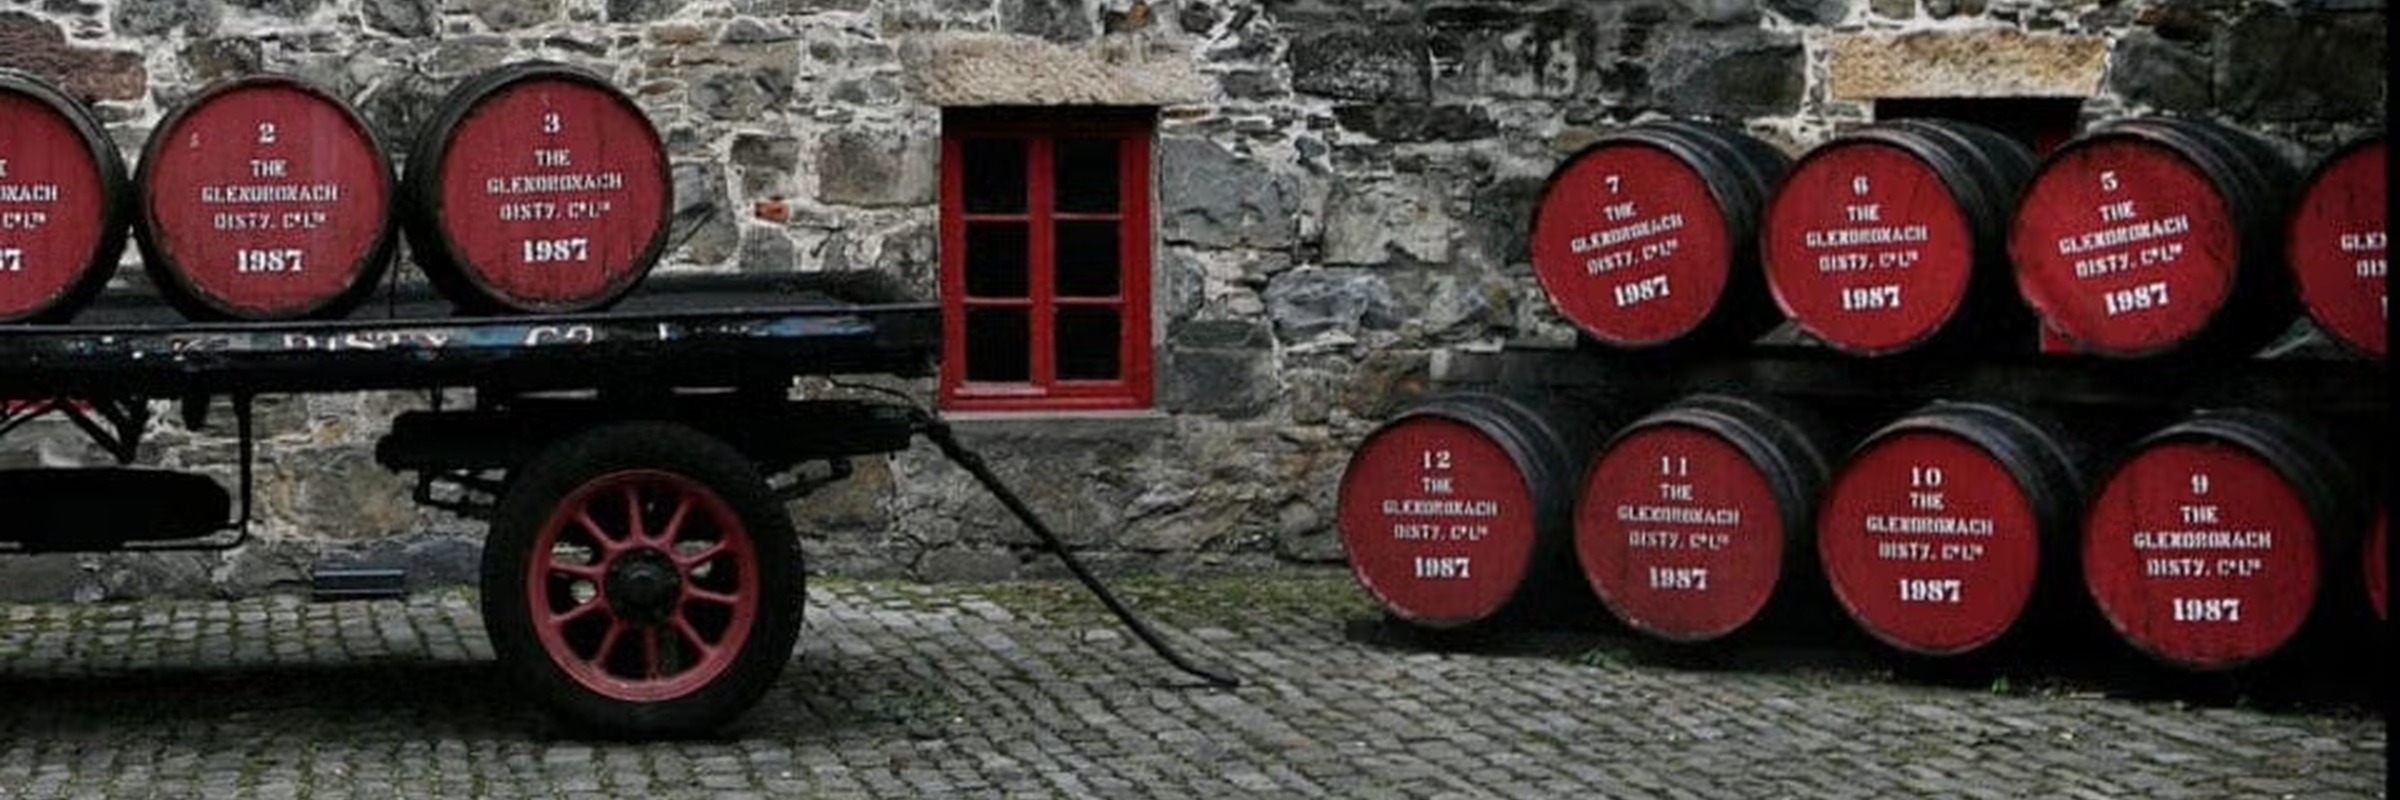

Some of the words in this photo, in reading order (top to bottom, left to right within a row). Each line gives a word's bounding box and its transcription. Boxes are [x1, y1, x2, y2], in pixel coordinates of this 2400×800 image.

[259, 122, 276, 143] 2
[544, 113, 560, 133] 3
[535, 149, 571, 166] THE
[250, 159, 287, 177] THE
[487, 172, 622, 193] GLENDRONACH
[1605, 176, 1619, 194] 7
[1853, 176, 1869, 195] 6
[2101, 170, 2117, 190] 5
[202, 184, 338, 203] GLENDRONACH
[1603, 201, 1636, 221] THE
[1846, 204, 1880, 221] THE
[2099, 200, 2136, 221] THE
[1571, 214, 1682, 253] GLENDRONACH
[1806, 226, 1927, 247] GLENDRONACH
[2060, 214, 2188, 254] GLENDRONACH
[524, 238, 587, 262] 1987
[238, 250, 302, 272] 1987
[1615, 275, 1669, 306] 1987
[1843, 285, 1899, 309] 1987
[2105, 282, 2168, 315] 1987
[1424, 450, 1451, 469] 12
[1662, 456, 1687, 476] 11
[1422, 477, 1453, 493] THE
[1911, 466, 1942, 487] 10
[2191, 474, 2208, 494] 9
[1660, 484, 1693, 500] THE
[1910, 491, 1944, 510] THE
[1383, 499, 1497, 517] GLENDRONACH
[1617, 505, 1739, 527] GLENDRONACH
[2180, 506, 2219, 523] THE
[1866, 515, 1993, 536] GLENDRONACH
[2133, 531, 2272, 549] GLENDRONACH
[1415, 556, 1470, 578] 1987
[1650, 567, 1707, 589] 1987
[1900, 579, 1961, 602] 1987
[2173, 598, 2239, 621] 1987
